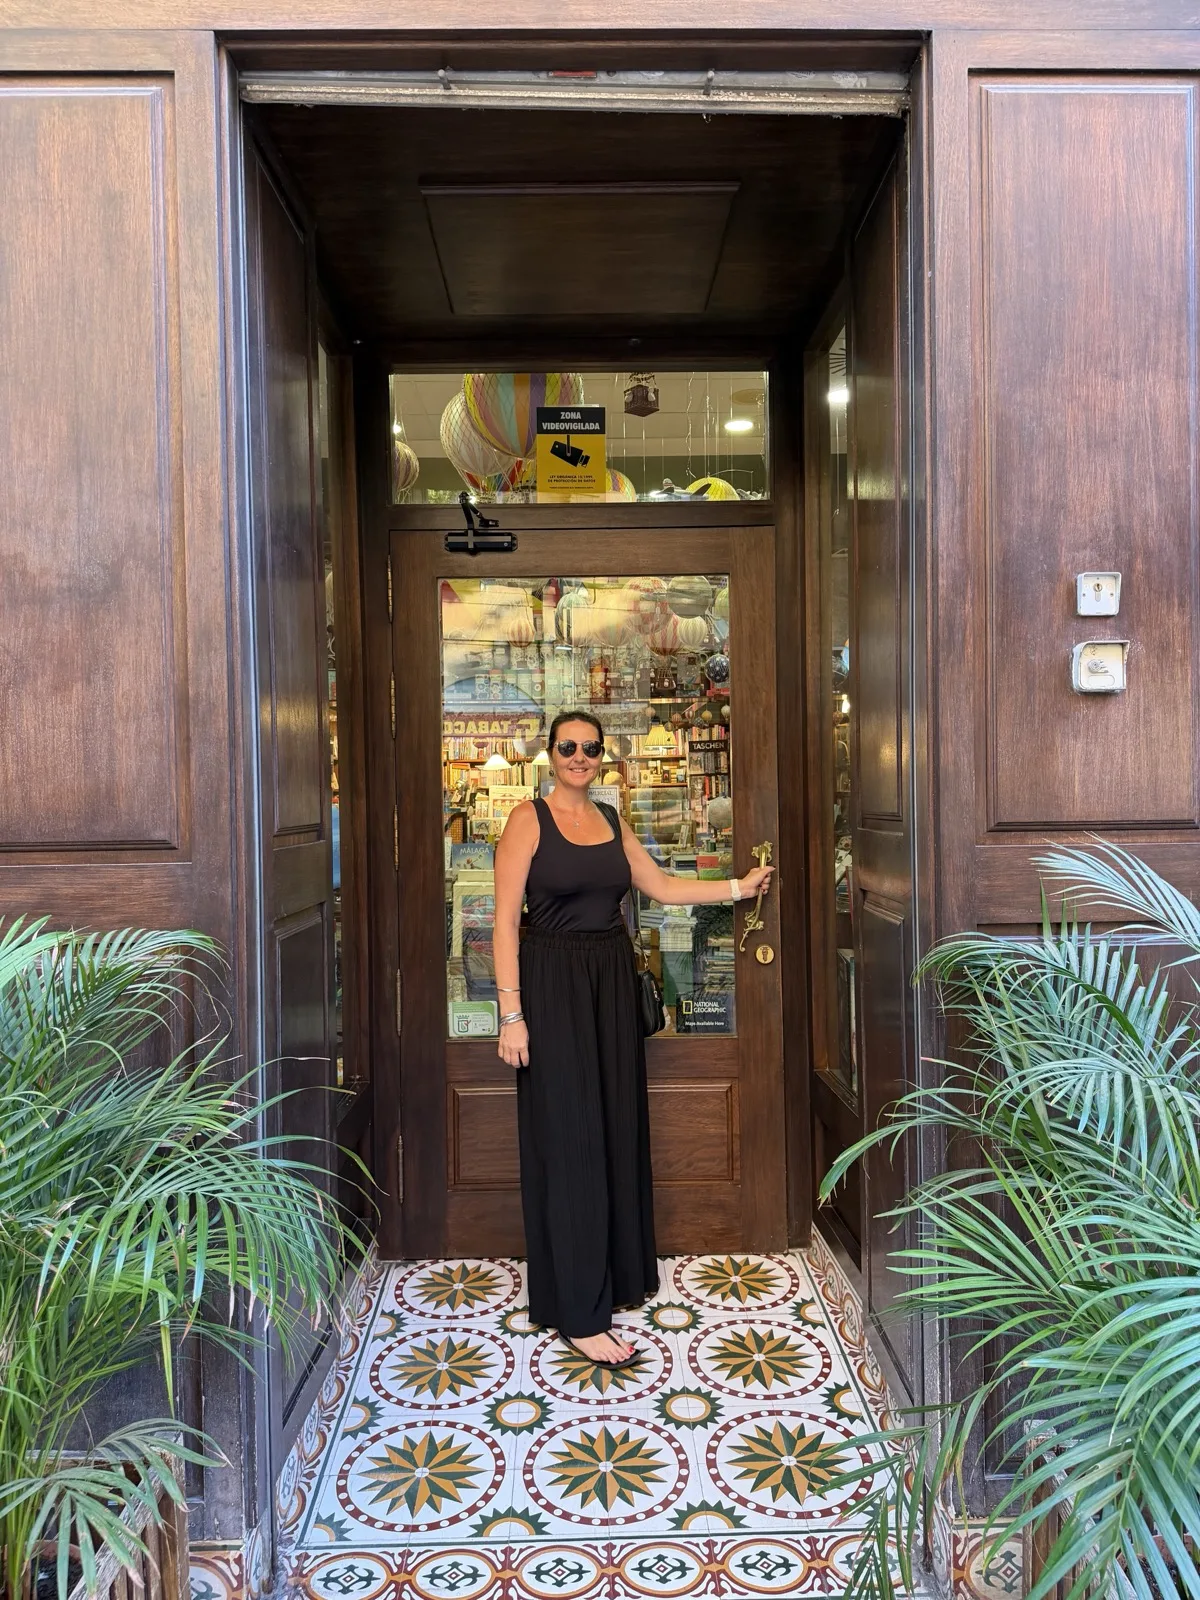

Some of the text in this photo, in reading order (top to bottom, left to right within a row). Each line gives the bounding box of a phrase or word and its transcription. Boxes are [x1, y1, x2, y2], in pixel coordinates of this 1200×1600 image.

[542, 422, 600, 430] VIDEOVIGILADA
[692, 742, 725, 750] TASCHEN
[460, 846, 490, 854] MÁLAGA
